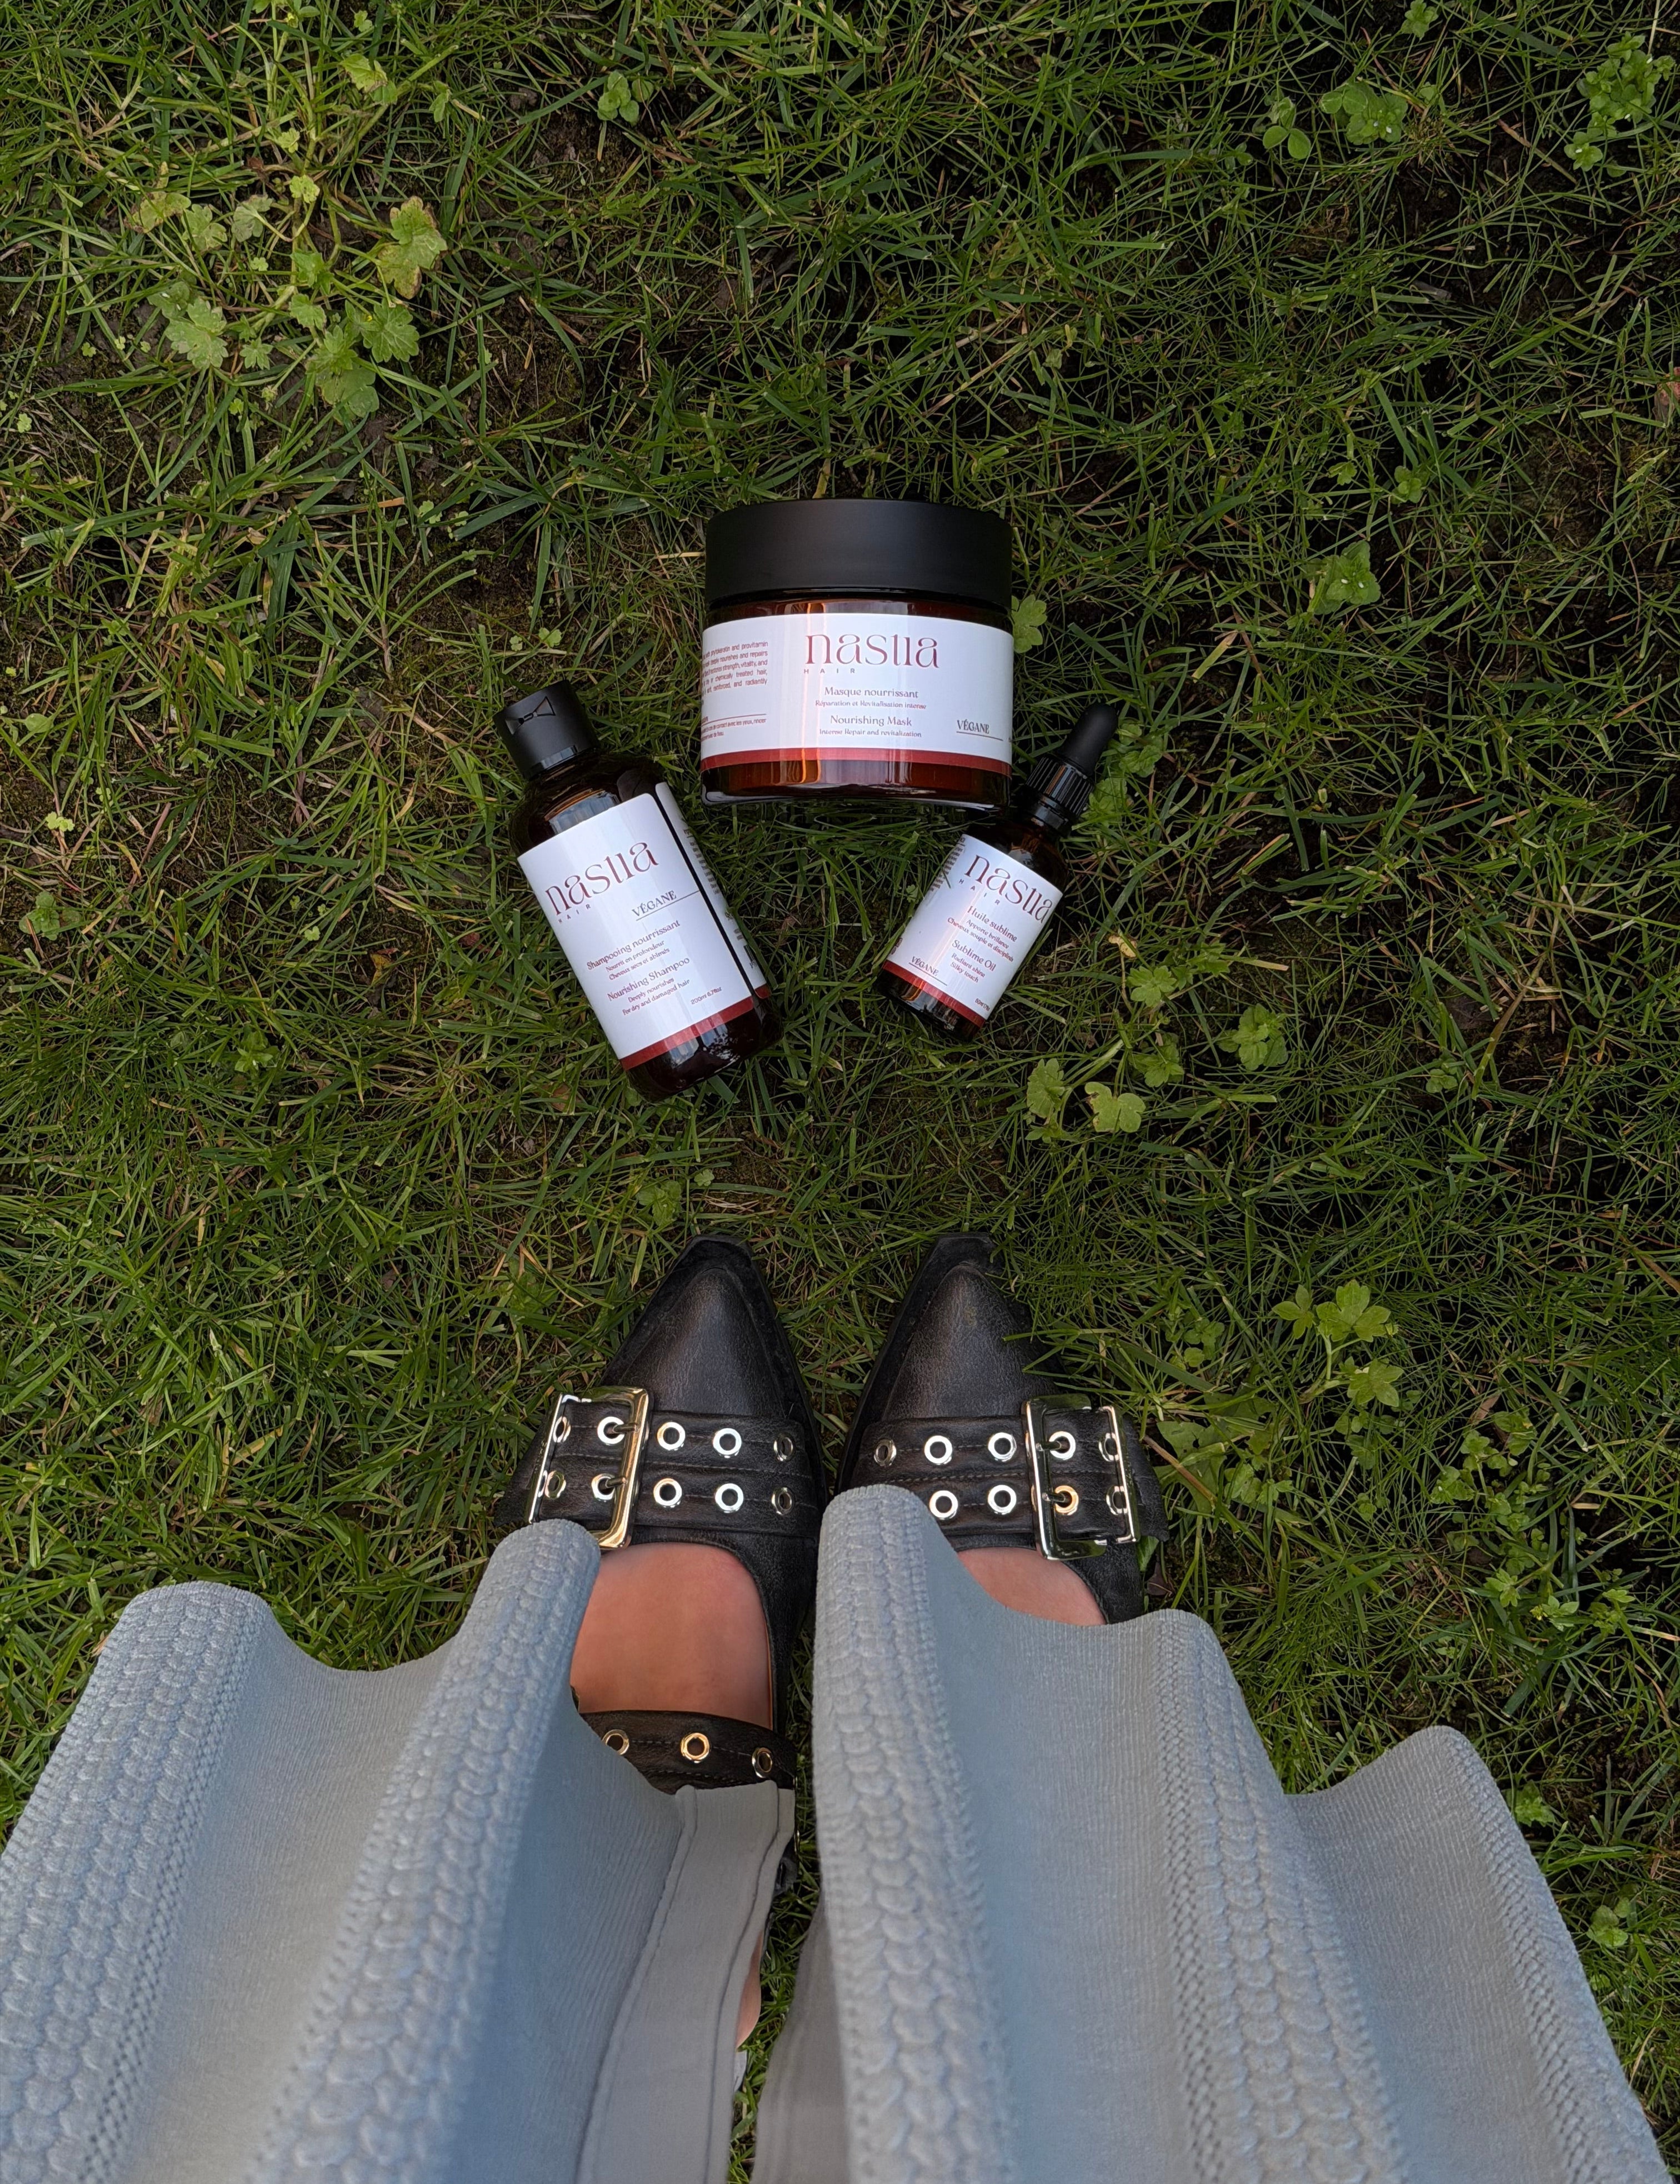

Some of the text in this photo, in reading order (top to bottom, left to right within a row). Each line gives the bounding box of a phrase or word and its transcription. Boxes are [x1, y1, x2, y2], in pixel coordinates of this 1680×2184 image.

[741, 641, 768, 650] provitamin
[824, 687, 919, 698] Masque nourrissant
[830, 715, 912, 727] Nourishing Mask
[957, 719, 989, 734] VÉGANE
[632, 890, 677, 917] VÉGANE
[947, 917, 969, 933] Cheveux
[969, 931, 987, 944] souple
[966, 919, 988, 936] Apporte
[967, 906, 1017, 942] Huile sublime
[587, 920, 681, 970] Shampooing nourrissant
[633, 940, 664, 960] profondeur
[952, 939, 996, 971] Sublime Oil
[912, 956, 939, 977] VÉGANE
[951, 953, 972, 969] Radiant
[607, 958, 689, 1001] Nourishing Shampoo
[609, 968, 631, 980] Cheveux
[951, 962, 979, 983] Silky touch
[628, 977, 674, 1003] Deeply nourishes
[631, 1003, 641, 1011] dry
[641, 997, 651, 1007] and
[652, 984, 677, 1001] damaged
[678, 978, 690, 988] hair
